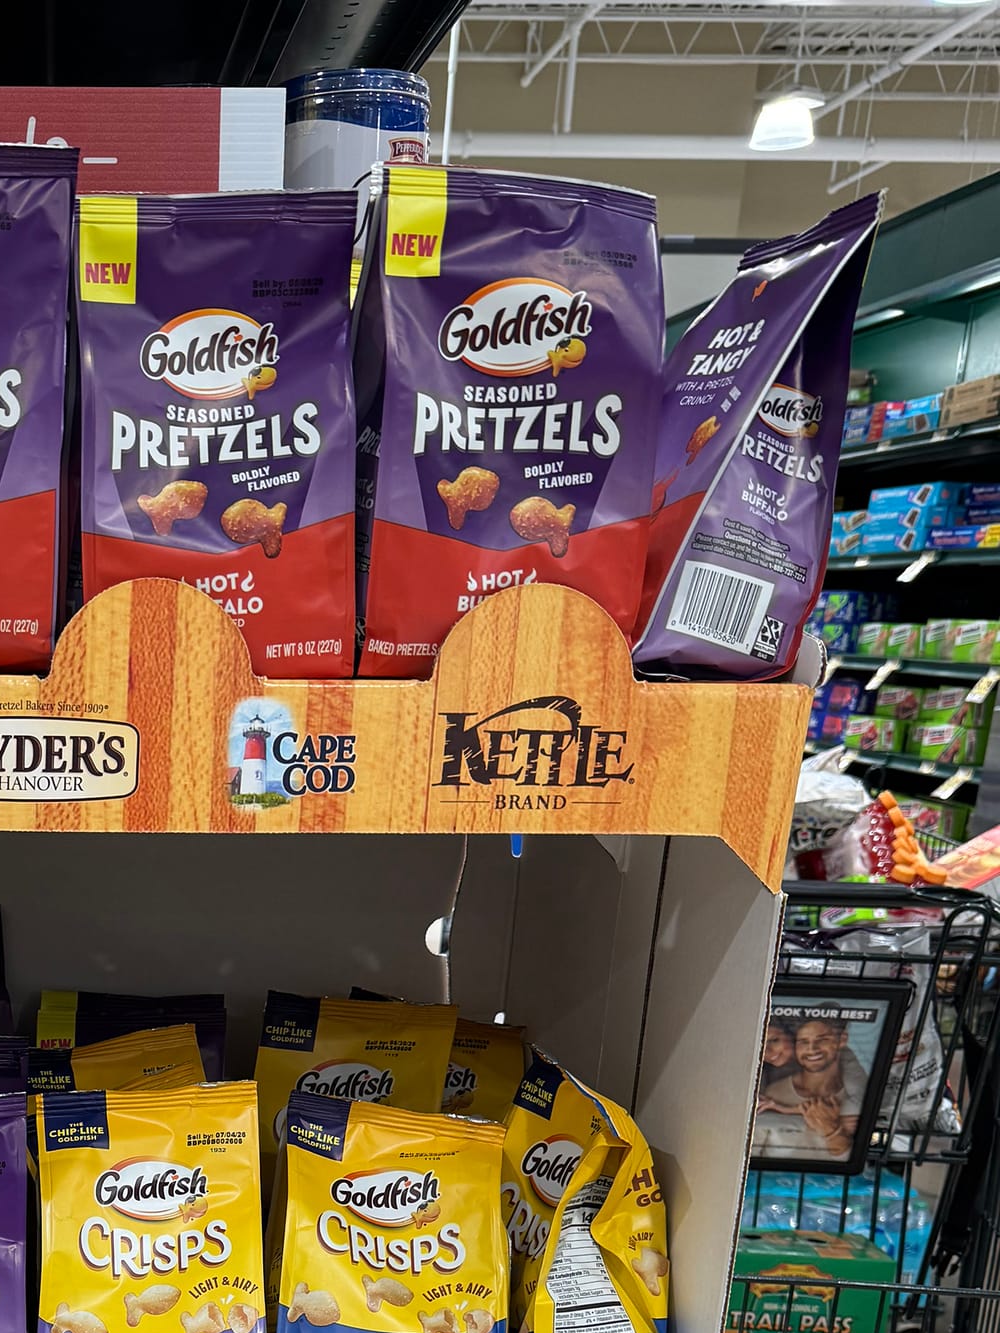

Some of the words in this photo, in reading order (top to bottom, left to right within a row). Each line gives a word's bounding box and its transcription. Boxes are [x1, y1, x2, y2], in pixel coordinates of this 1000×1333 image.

[441, 293, 592, 361] Goldfish
[708, 322, 749, 350] HOT
[749, 319, 765, 342] &
[142, 323, 279, 377] Goldfish
[687, 345, 755, 377] TANGY
[679, 394, 715, 407] CRUNCH
[111, 403, 320, 472] PRETZELS
[412, 391, 622, 457] PRETZELS
[0, 619, 13, 634] OZ
[14, 619, 39, 636] (227g)
[272, 732, 357, 764] CAPE
[432, 695, 634, 790] KETTLE
[282, 762, 355, 794] COD
[494, 794, 567, 811] BRAND
[804, 1009, 839, 1018] YOUR
[841, 1010, 872, 1019] BEST
[58, 1135, 96, 1143] GOLDFISH
[96, 1168, 208, 1204] Goldfish
[332, 1171, 440, 1209] Goldfish
[80, 1216, 232, 1277] CRISPS
[318, 1210, 467, 1276] CRISPS
[187, 1278, 219, 1300] LIGHT
[222, 1277, 231, 1286] &
[232, 1276, 258, 1295] AIRY
[800, 1315, 852, 1333] PASS
